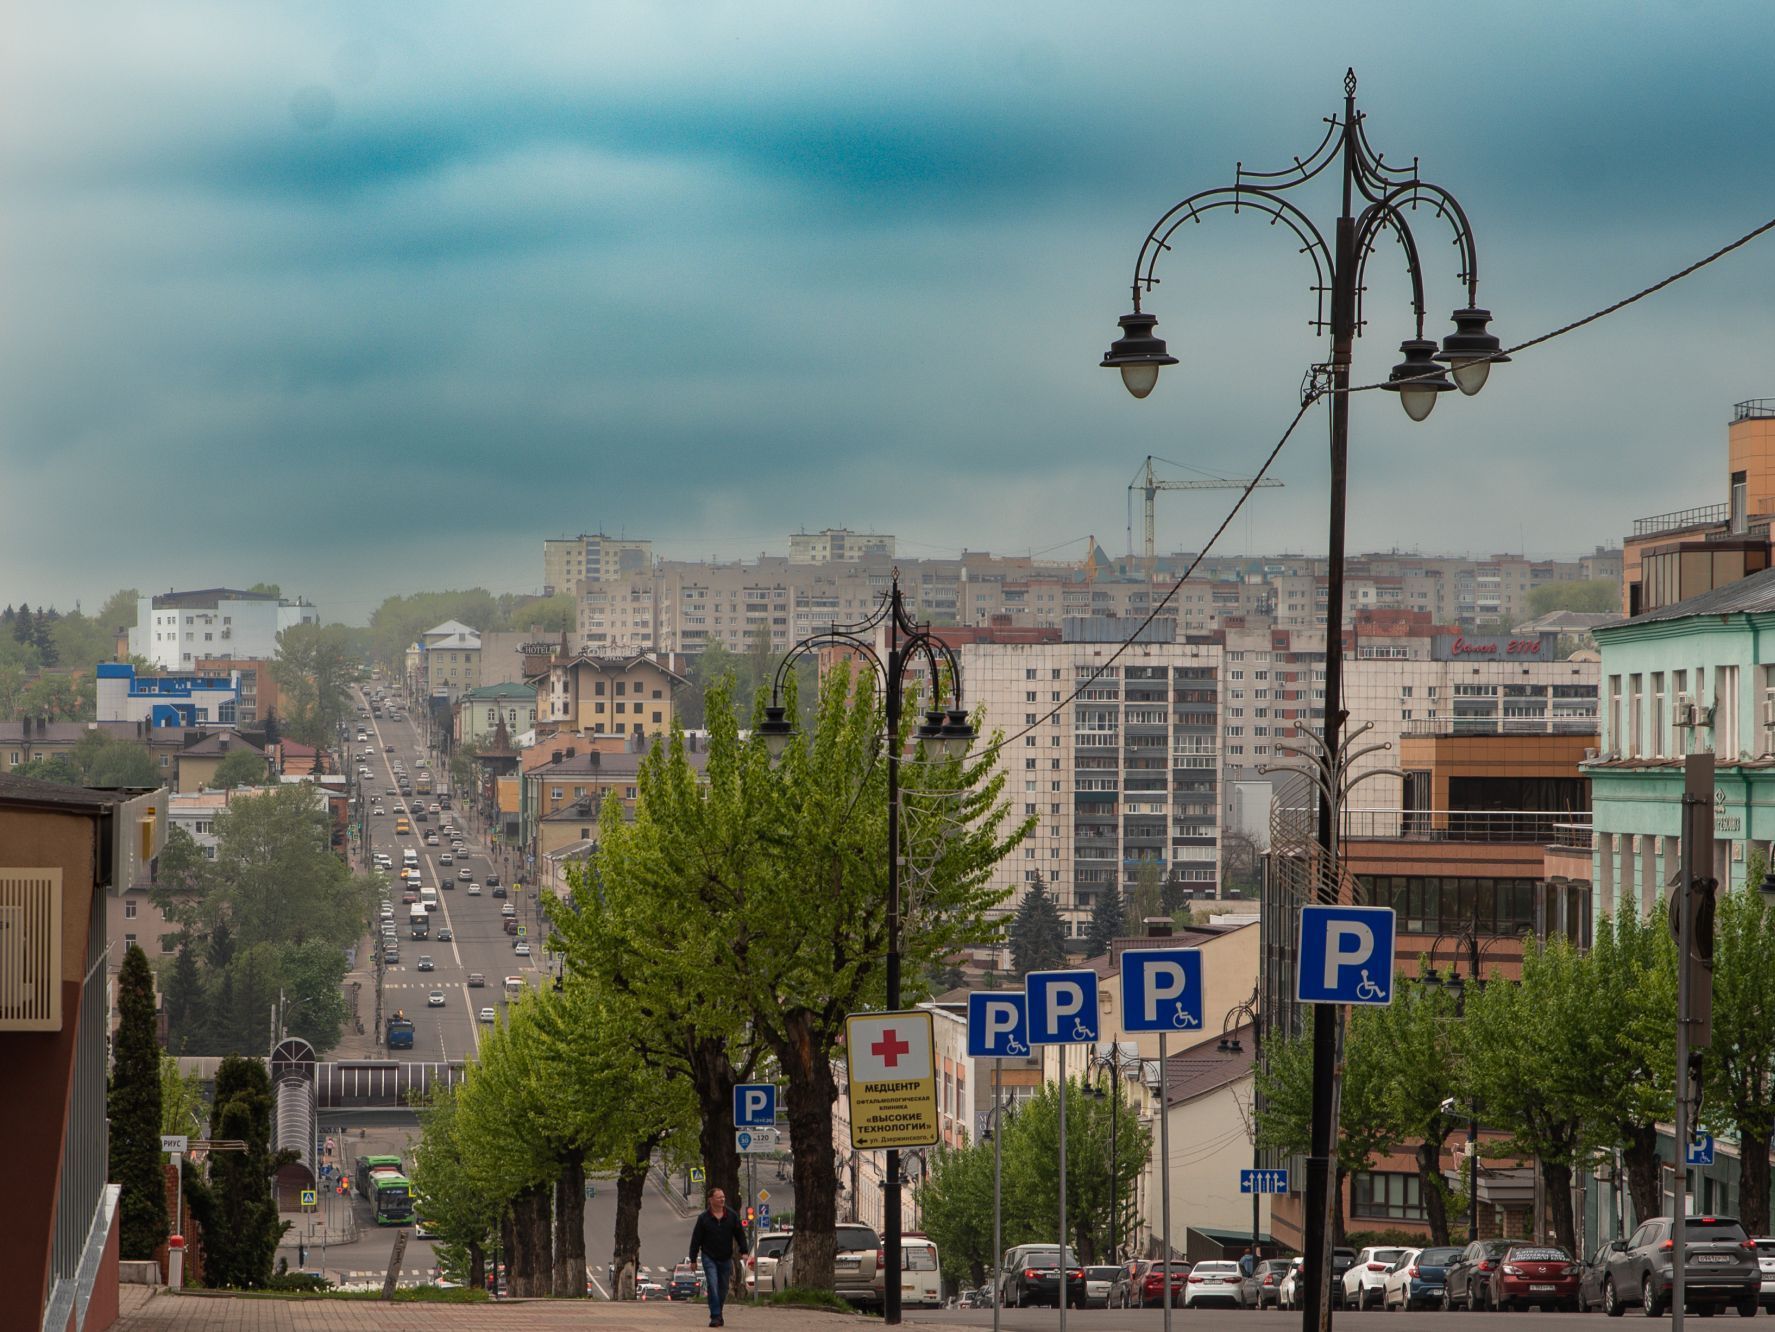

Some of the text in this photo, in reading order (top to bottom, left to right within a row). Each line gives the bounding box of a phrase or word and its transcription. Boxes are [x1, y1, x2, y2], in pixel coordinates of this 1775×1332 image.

[1323, 920, 1375, 989] P
[1046, 982, 1084, 1035] P
[1144, 961, 1186, 1021] P
[985, 1001, 1019, 1049] P
[745, 1090, 768, 1121] P
[865, 1082, 920, 1093] МЕДЦЕНТР
[857, 1122, 931, 1133] ТЕХНОЛОГИИ»
[866, 1113, 922, 1123] «ВЫСОКИЕ
